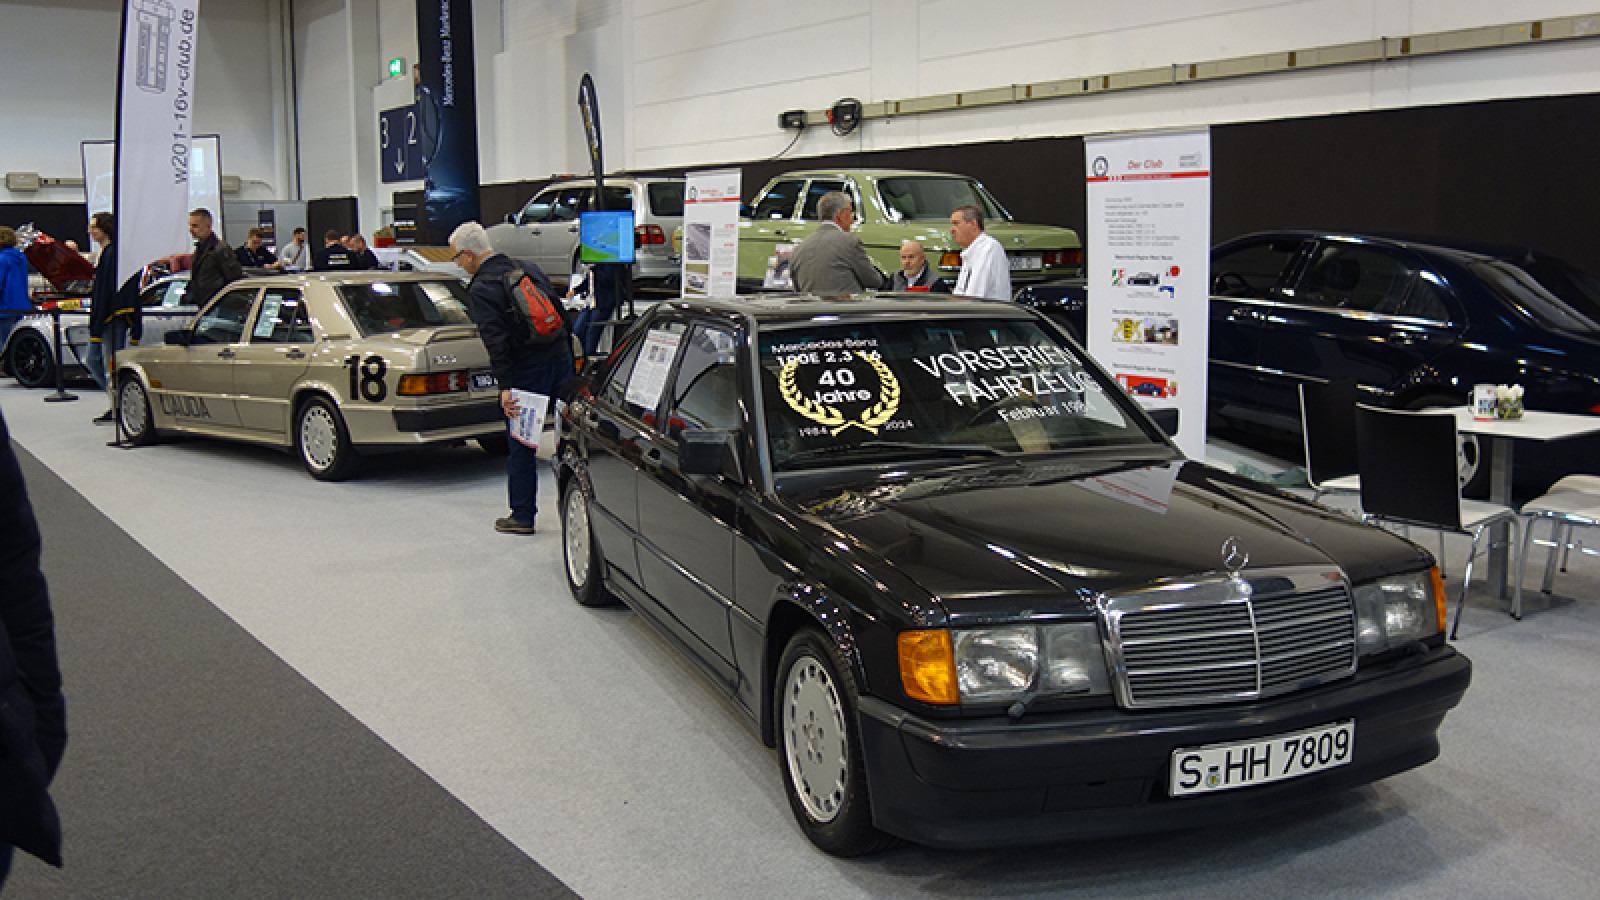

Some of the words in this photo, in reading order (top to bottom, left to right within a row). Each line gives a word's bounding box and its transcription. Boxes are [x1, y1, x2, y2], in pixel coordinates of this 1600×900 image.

[171, 9, 195, 184] w201-16v-club.de
[381, 118, 389, 149] 3
[406, 112, 417, 145] 2
[771, 338, 879, 354] Mercedes-Benz
[912, 346, 1083, 379] VORSERIEN
[343, 355, 388, 402] 18
[818, 367, 857, 387] 40
[943, 371, 1103, 406] FAHRZEUG
[811, 389, 872, 405] Jahre
[997, 405, 1061, 423] Februar
[1179, 743, 1272, 789] S-HH
[1281, 729, 1349, 775] 7809
